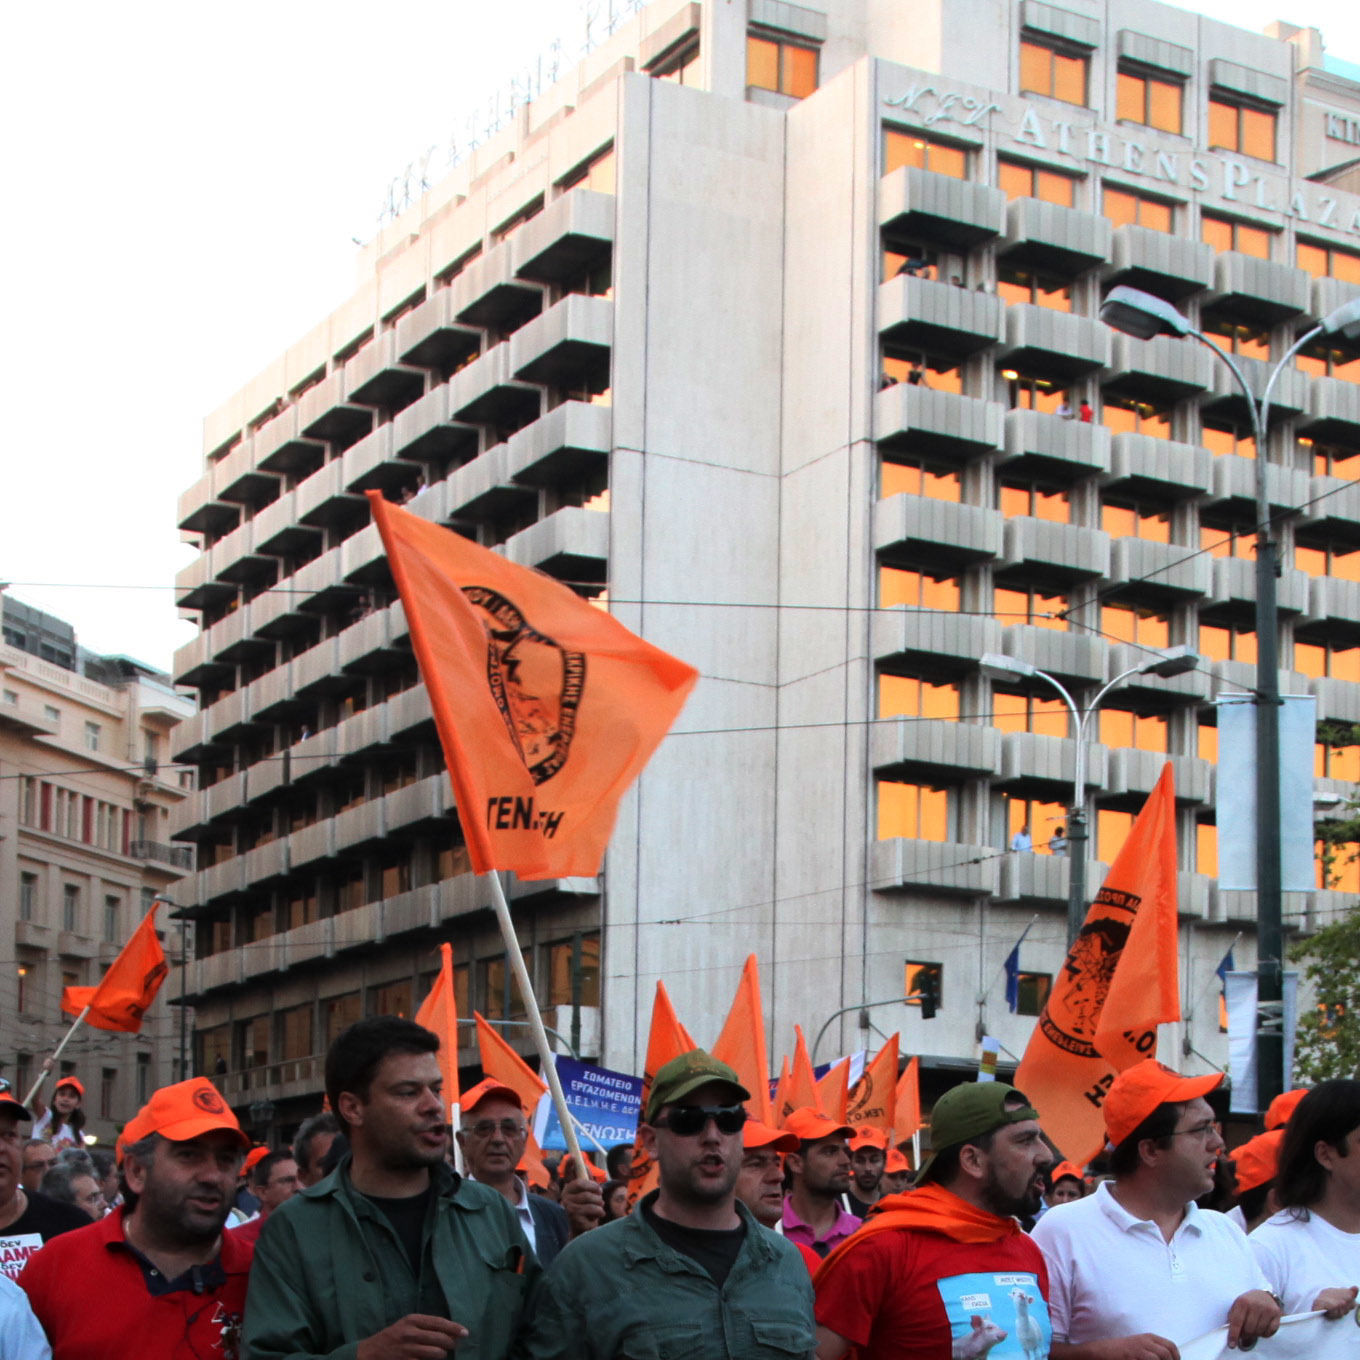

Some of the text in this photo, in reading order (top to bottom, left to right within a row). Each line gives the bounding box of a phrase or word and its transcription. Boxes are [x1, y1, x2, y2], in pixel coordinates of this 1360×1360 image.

[1014, 106, 1209, 192] ATHENS
[583, 1070, 632, 1090] ΣΩΜΑΤΕΙΟ
[571, 1080, 642, 1105] ΕΡΓΑΖΟΜΕΝΩΝ
[0, 1238, 22, 1249] δεν
